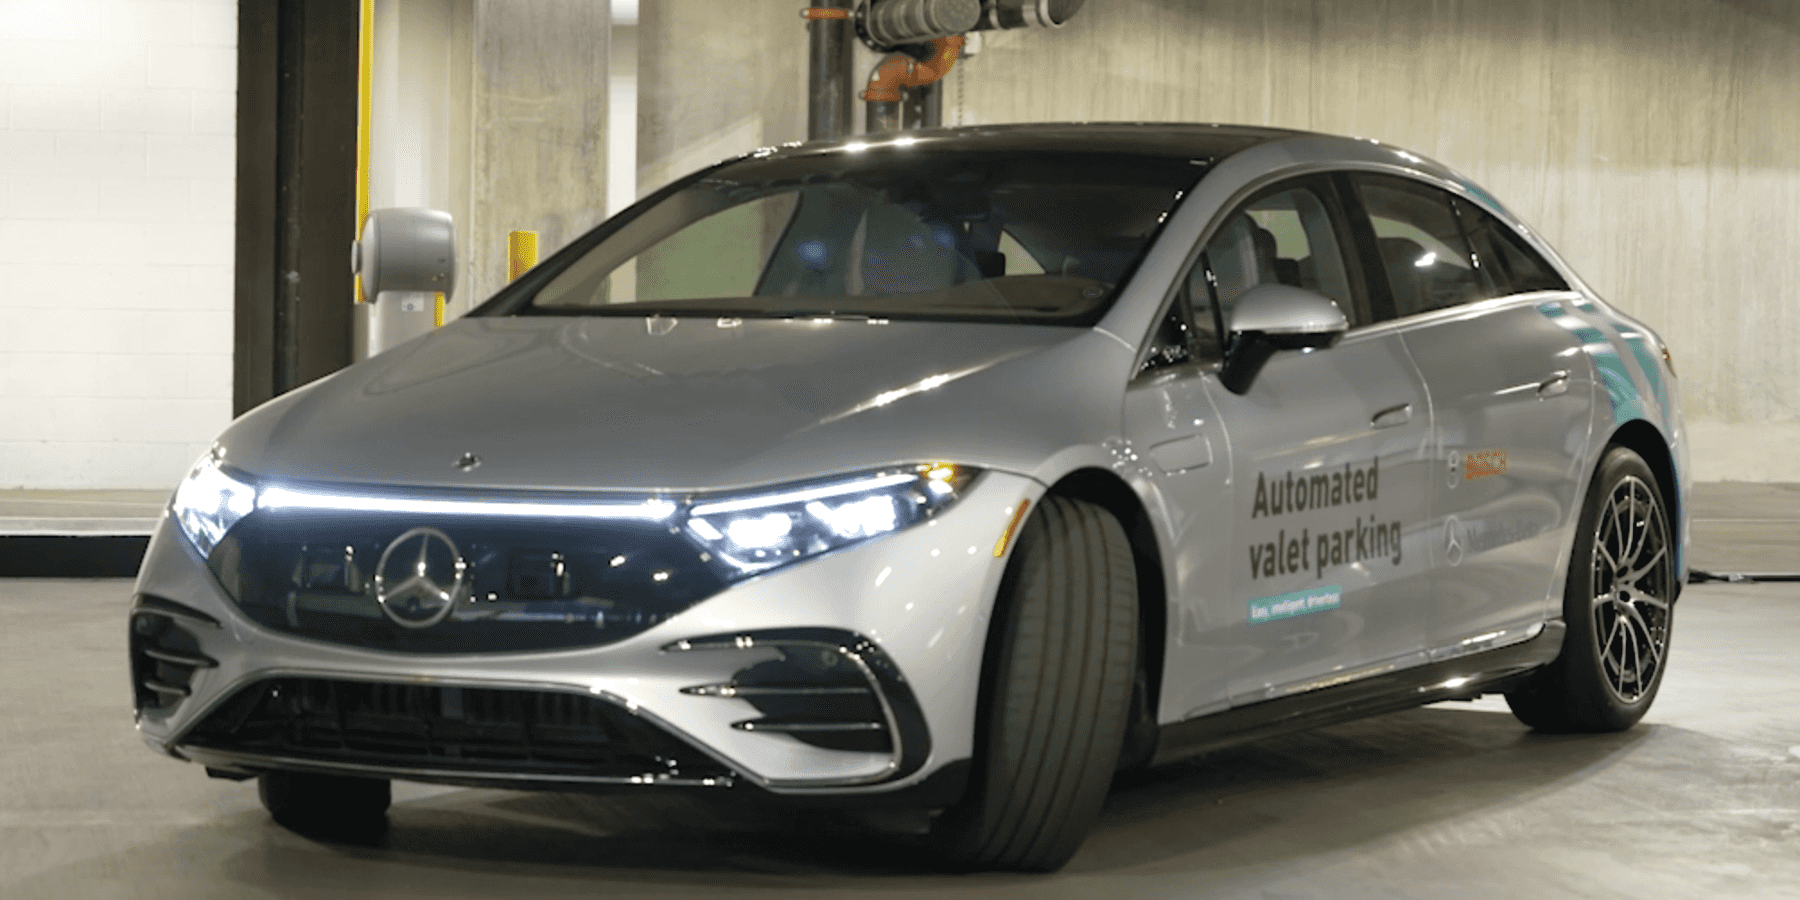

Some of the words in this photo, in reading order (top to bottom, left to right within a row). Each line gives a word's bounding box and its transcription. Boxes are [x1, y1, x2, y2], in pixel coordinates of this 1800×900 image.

[1251, 455, 1379, 519] Automated
[1250, 528, 1310, 580] valet
[1317, 513, 1402, 580] parking
